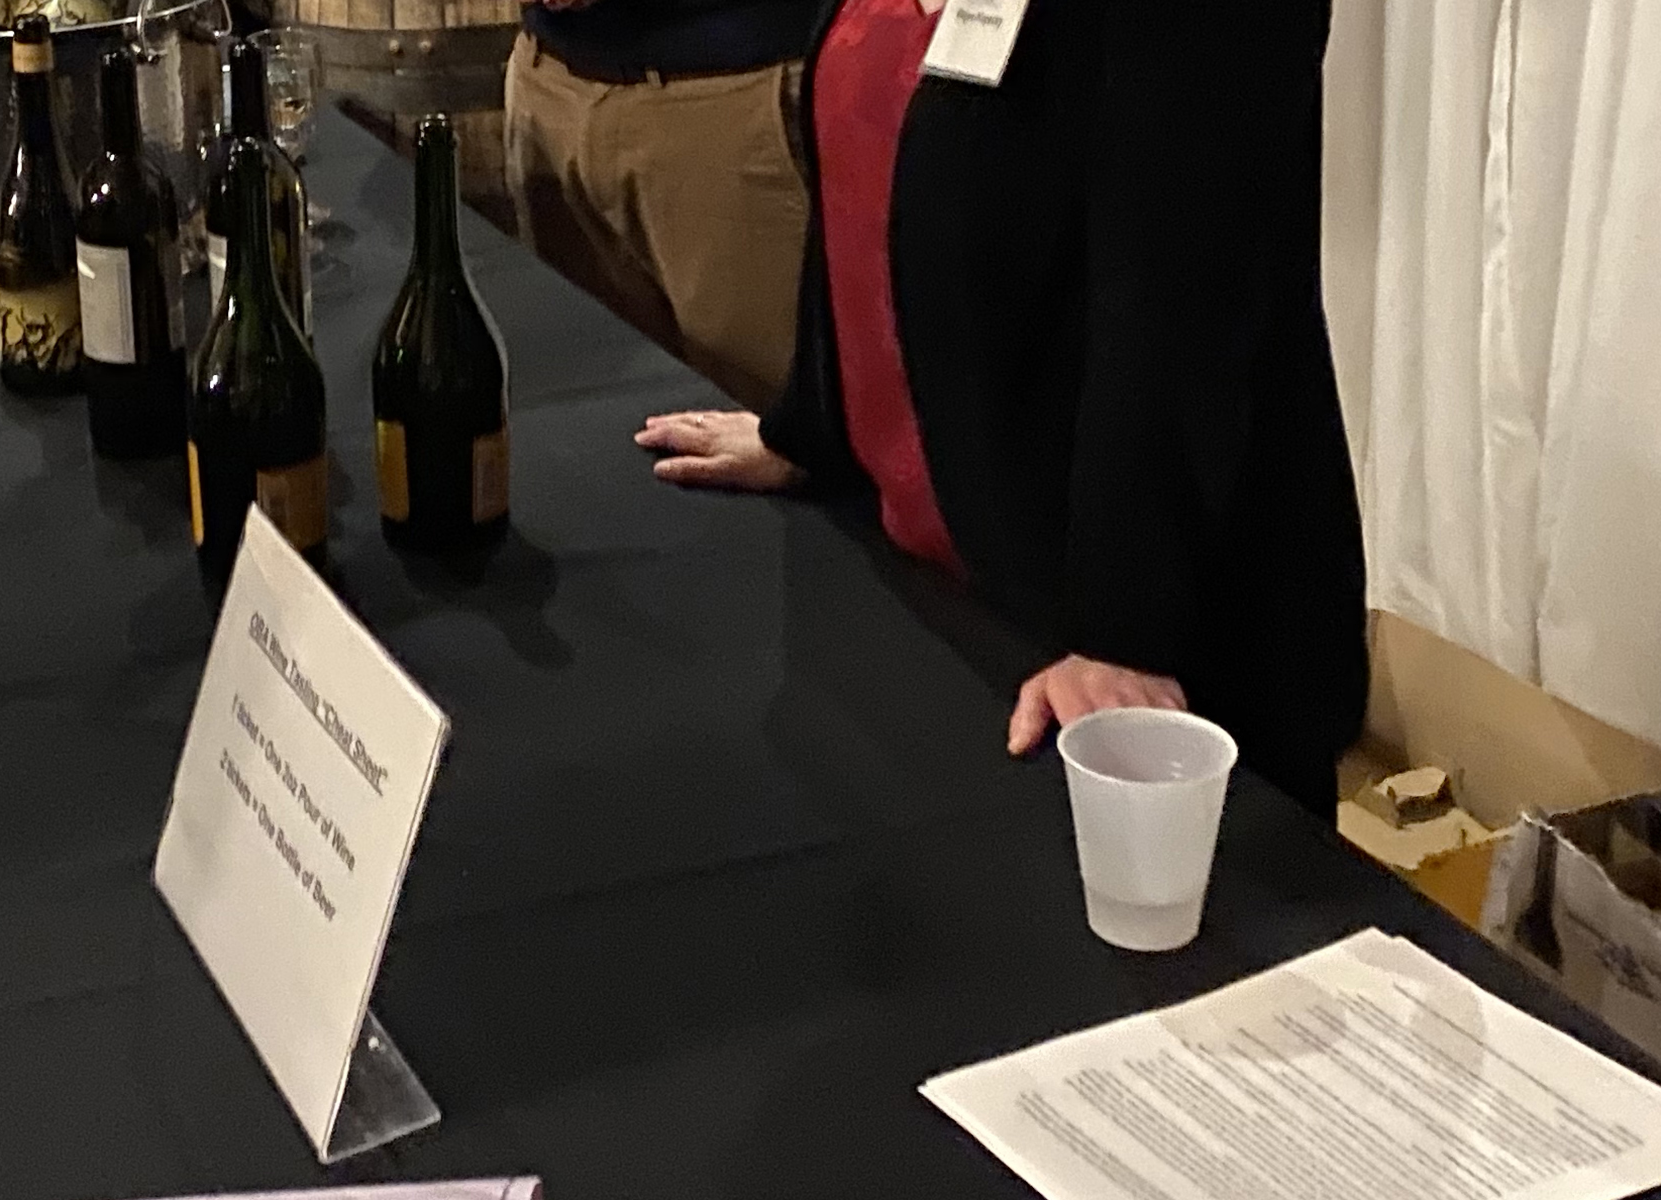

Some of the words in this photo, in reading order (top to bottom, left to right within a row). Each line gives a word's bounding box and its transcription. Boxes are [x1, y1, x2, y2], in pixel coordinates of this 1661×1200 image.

[289, 658, 320, 718] Tasting
[226, 759, 251, 807] tickets
[258, 802, 275, 839] One
[275, 827, 301, 877] Bottle
[301, 870, 314, 892] of
[313, 879, 336, 922] Beer
[265, 740, 282, 775] One
[298, 783, 321, 823] Pour
[320, 818, 333, 840] of
[332, 827, 355, 871] Wine
